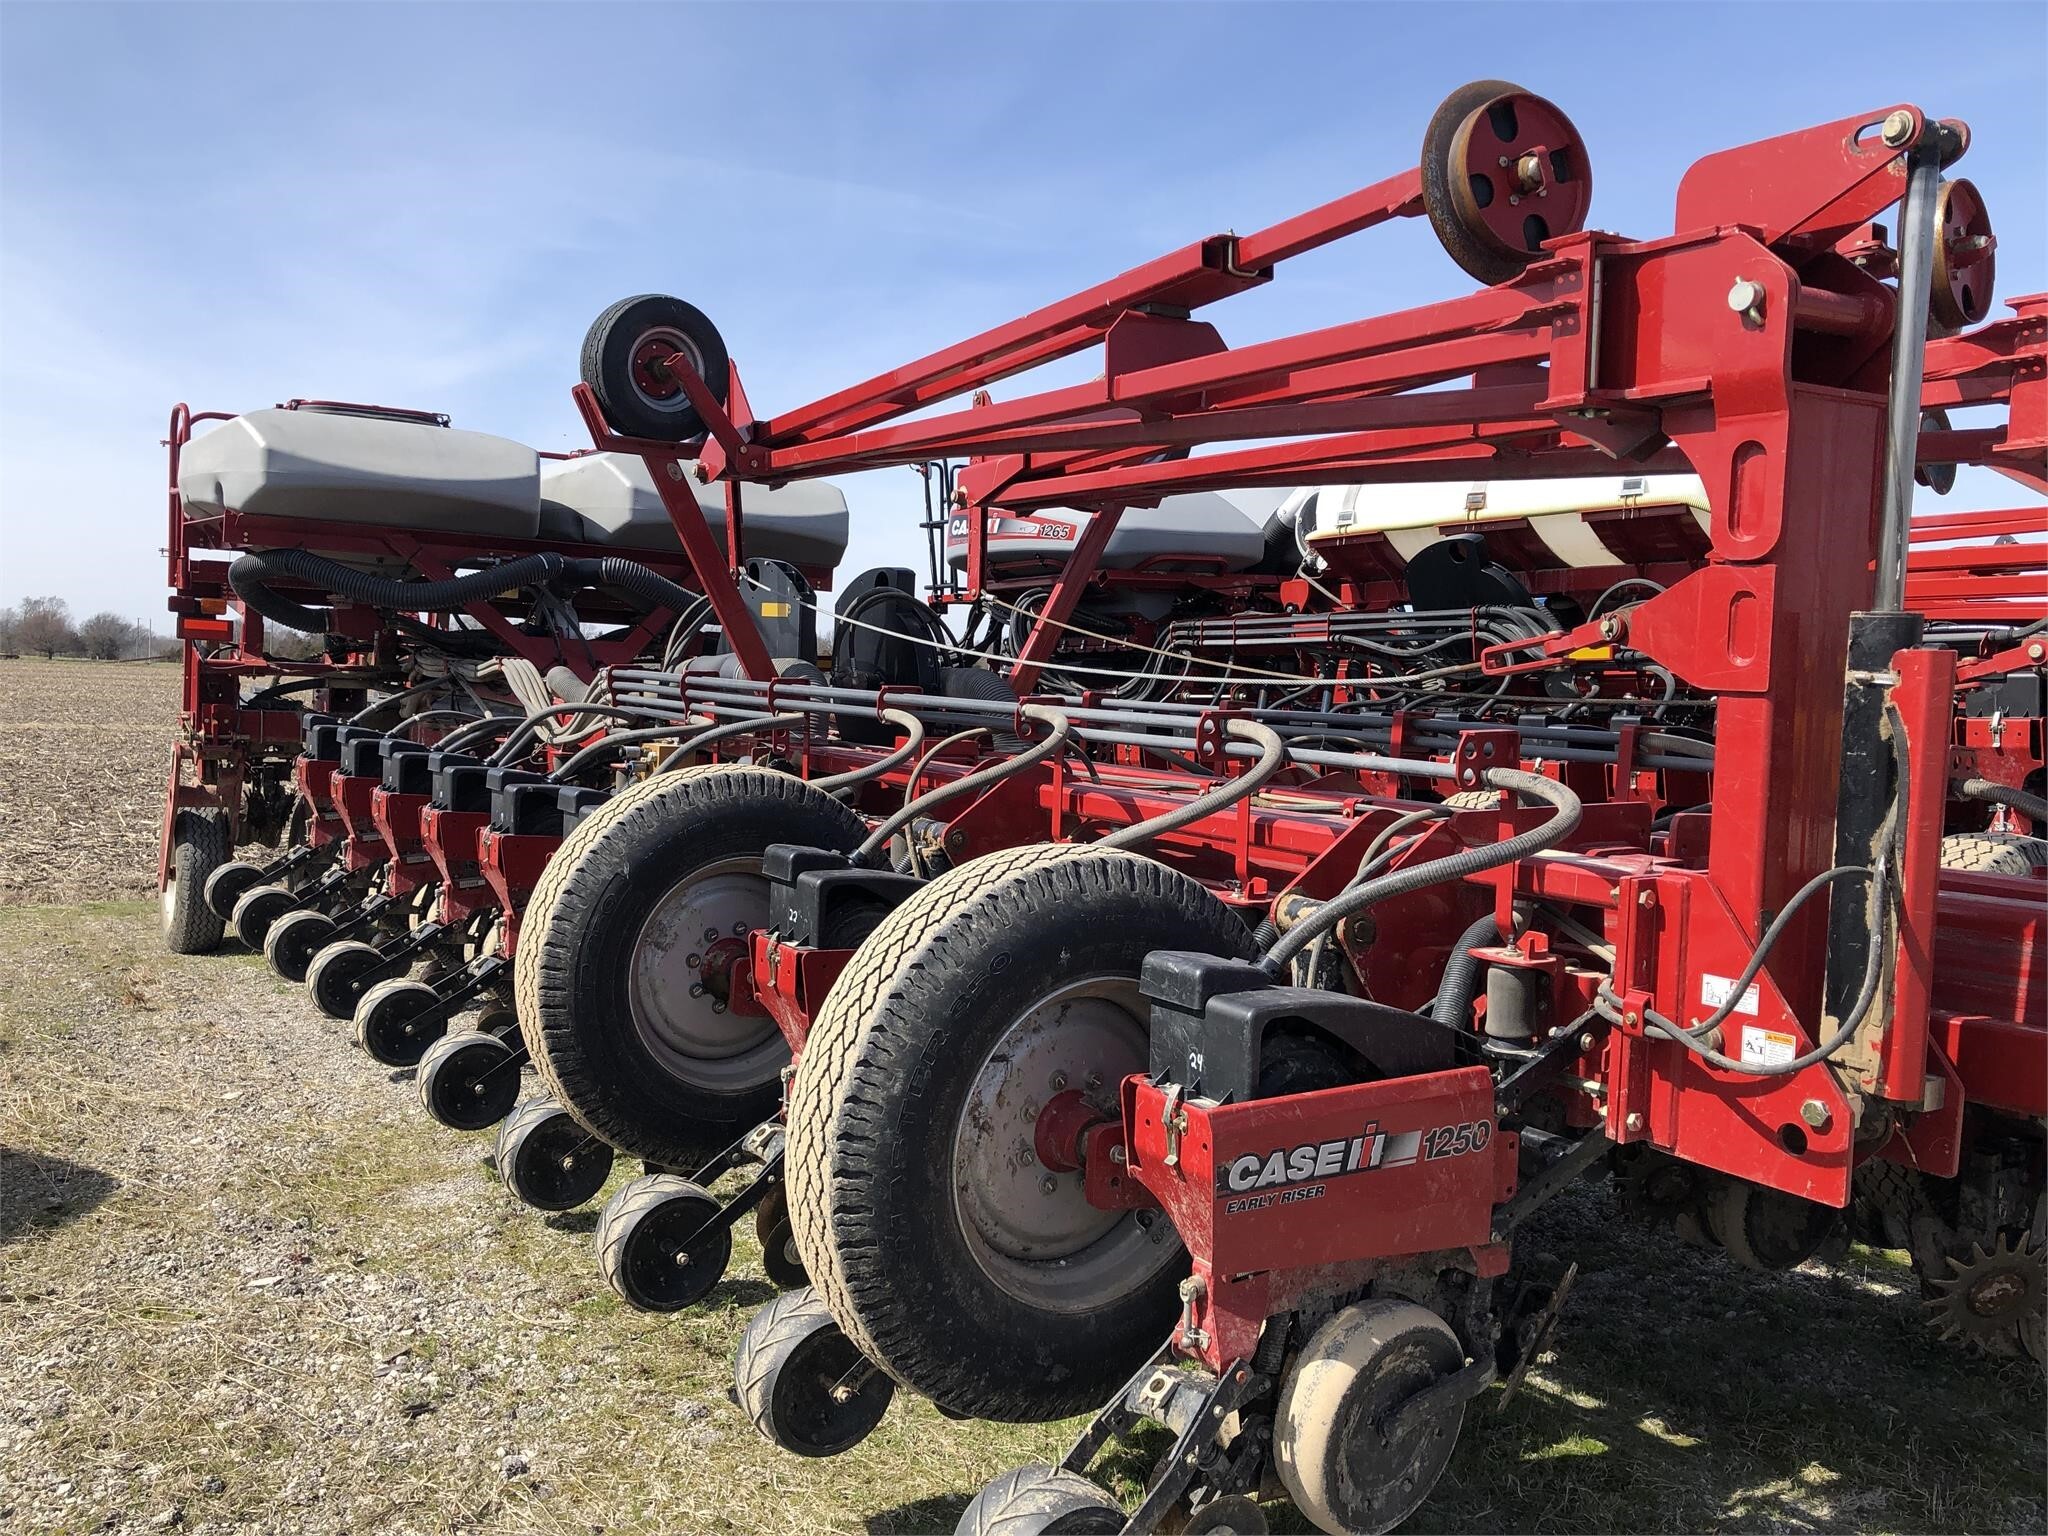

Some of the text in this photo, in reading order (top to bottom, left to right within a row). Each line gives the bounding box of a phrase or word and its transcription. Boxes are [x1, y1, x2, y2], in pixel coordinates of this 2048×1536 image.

[1040, 523, 1070, 540] 1265
[1189, 1052, 1203, 1072] 24
[1228, 1139, 1346, 1192] CASE
[1423, 1119, 1492, 1162] 1250
[1225, 1184, 1327, 1215] EARLY RISER
